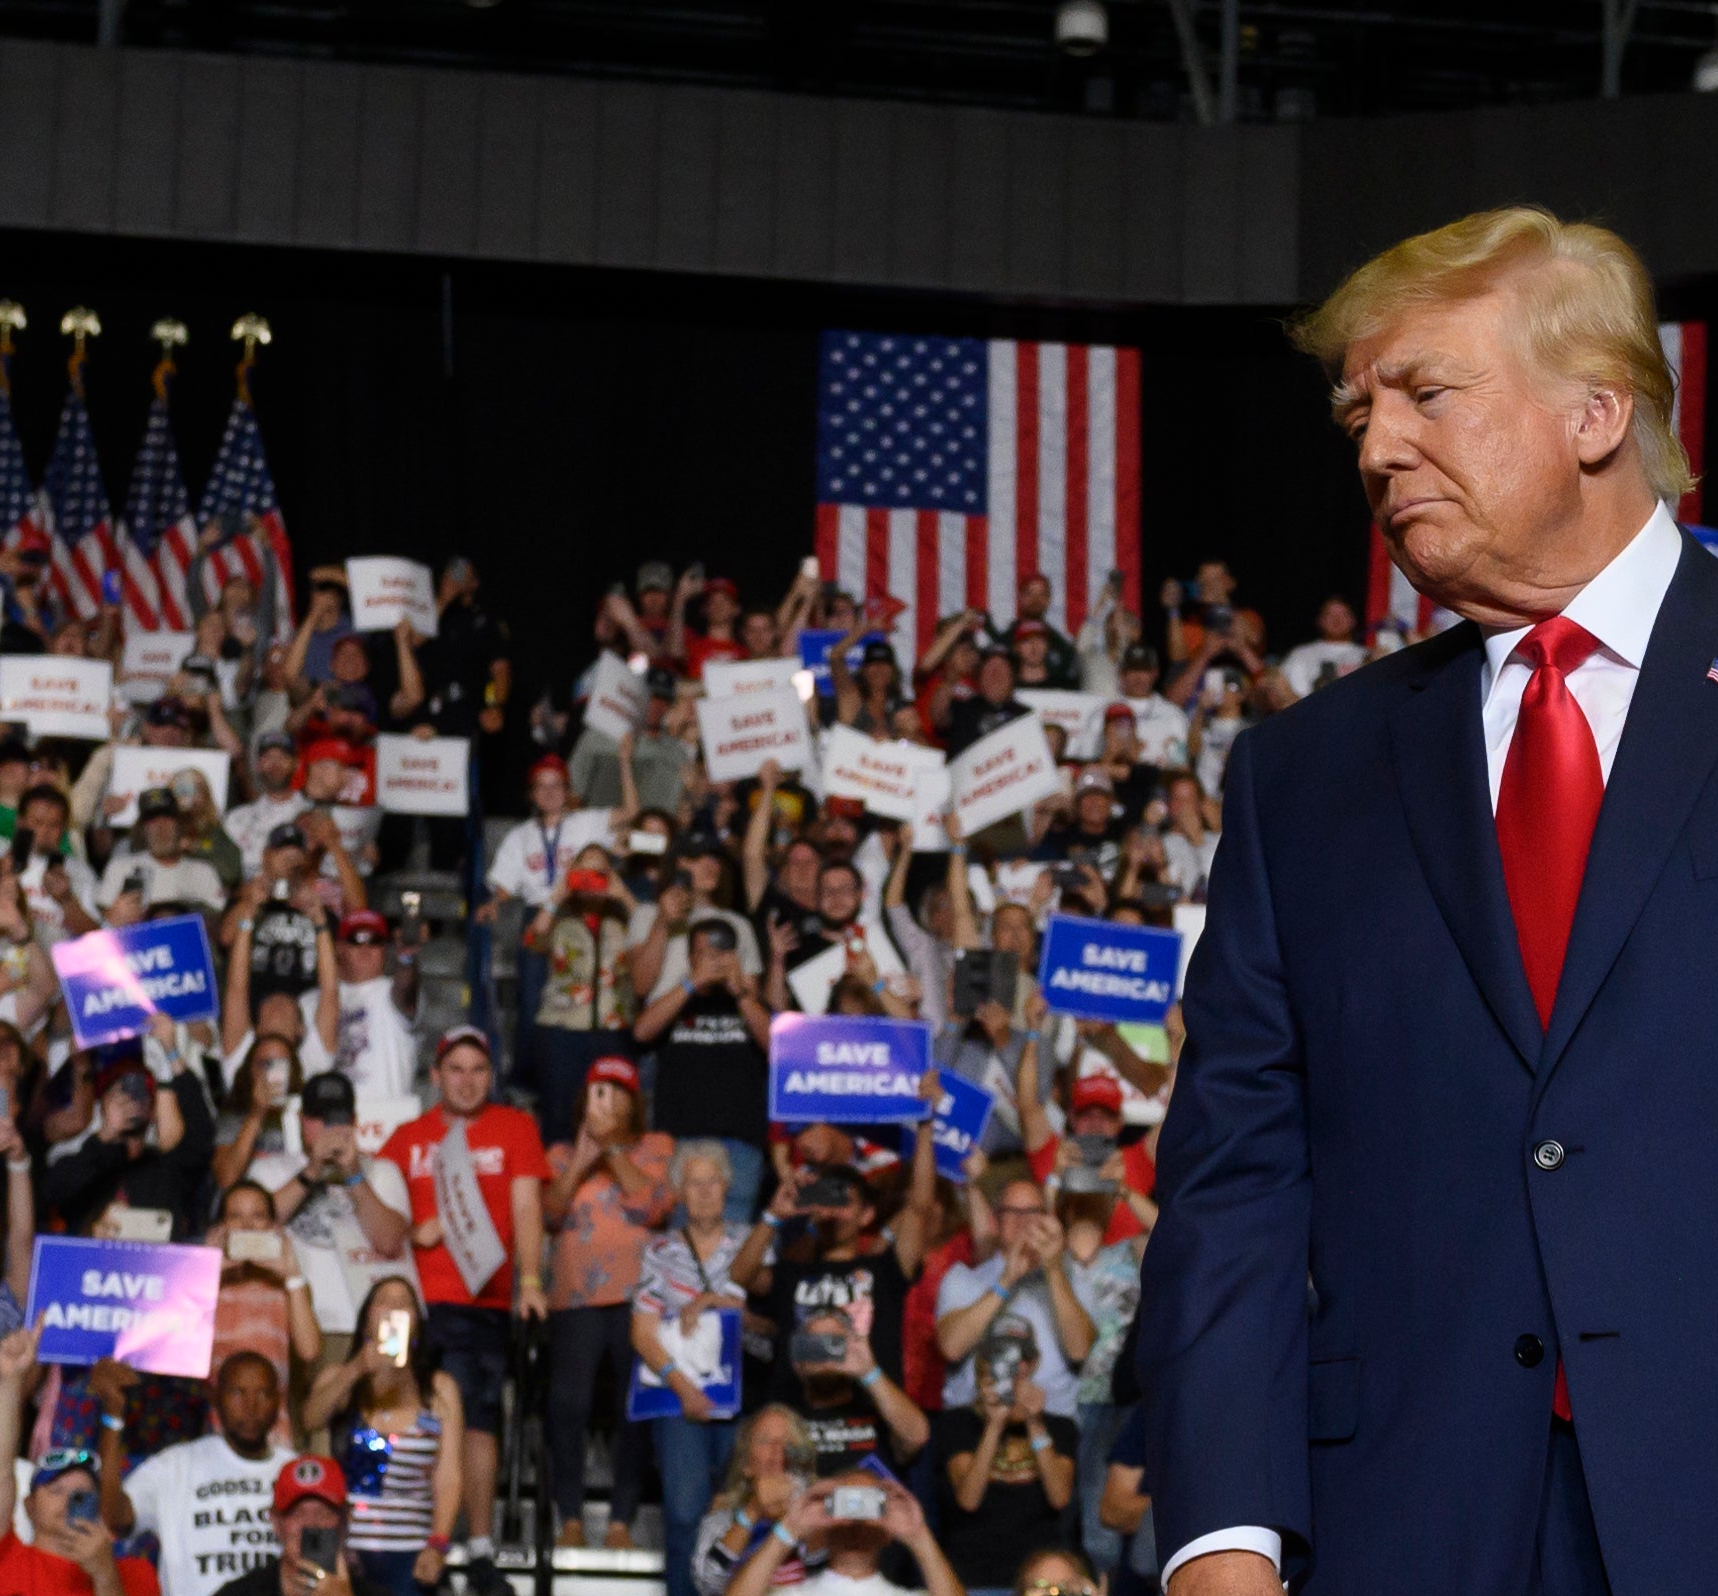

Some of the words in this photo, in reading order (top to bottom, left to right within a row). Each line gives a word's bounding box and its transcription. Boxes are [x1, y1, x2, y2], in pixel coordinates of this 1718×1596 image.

[1080, 941, 1147, 974] SAVE
[1048, 966, 1174, 1004] AMERICA!
[815, 1038, 891, 1069] SAVE
[783, 1068, 922, 1101] AMERICA!
[81, 1268, 165, 1303] SAVE
[193, 1506, 273, 1529] BLAC
[194, 1551, 279, 1576] TRU
